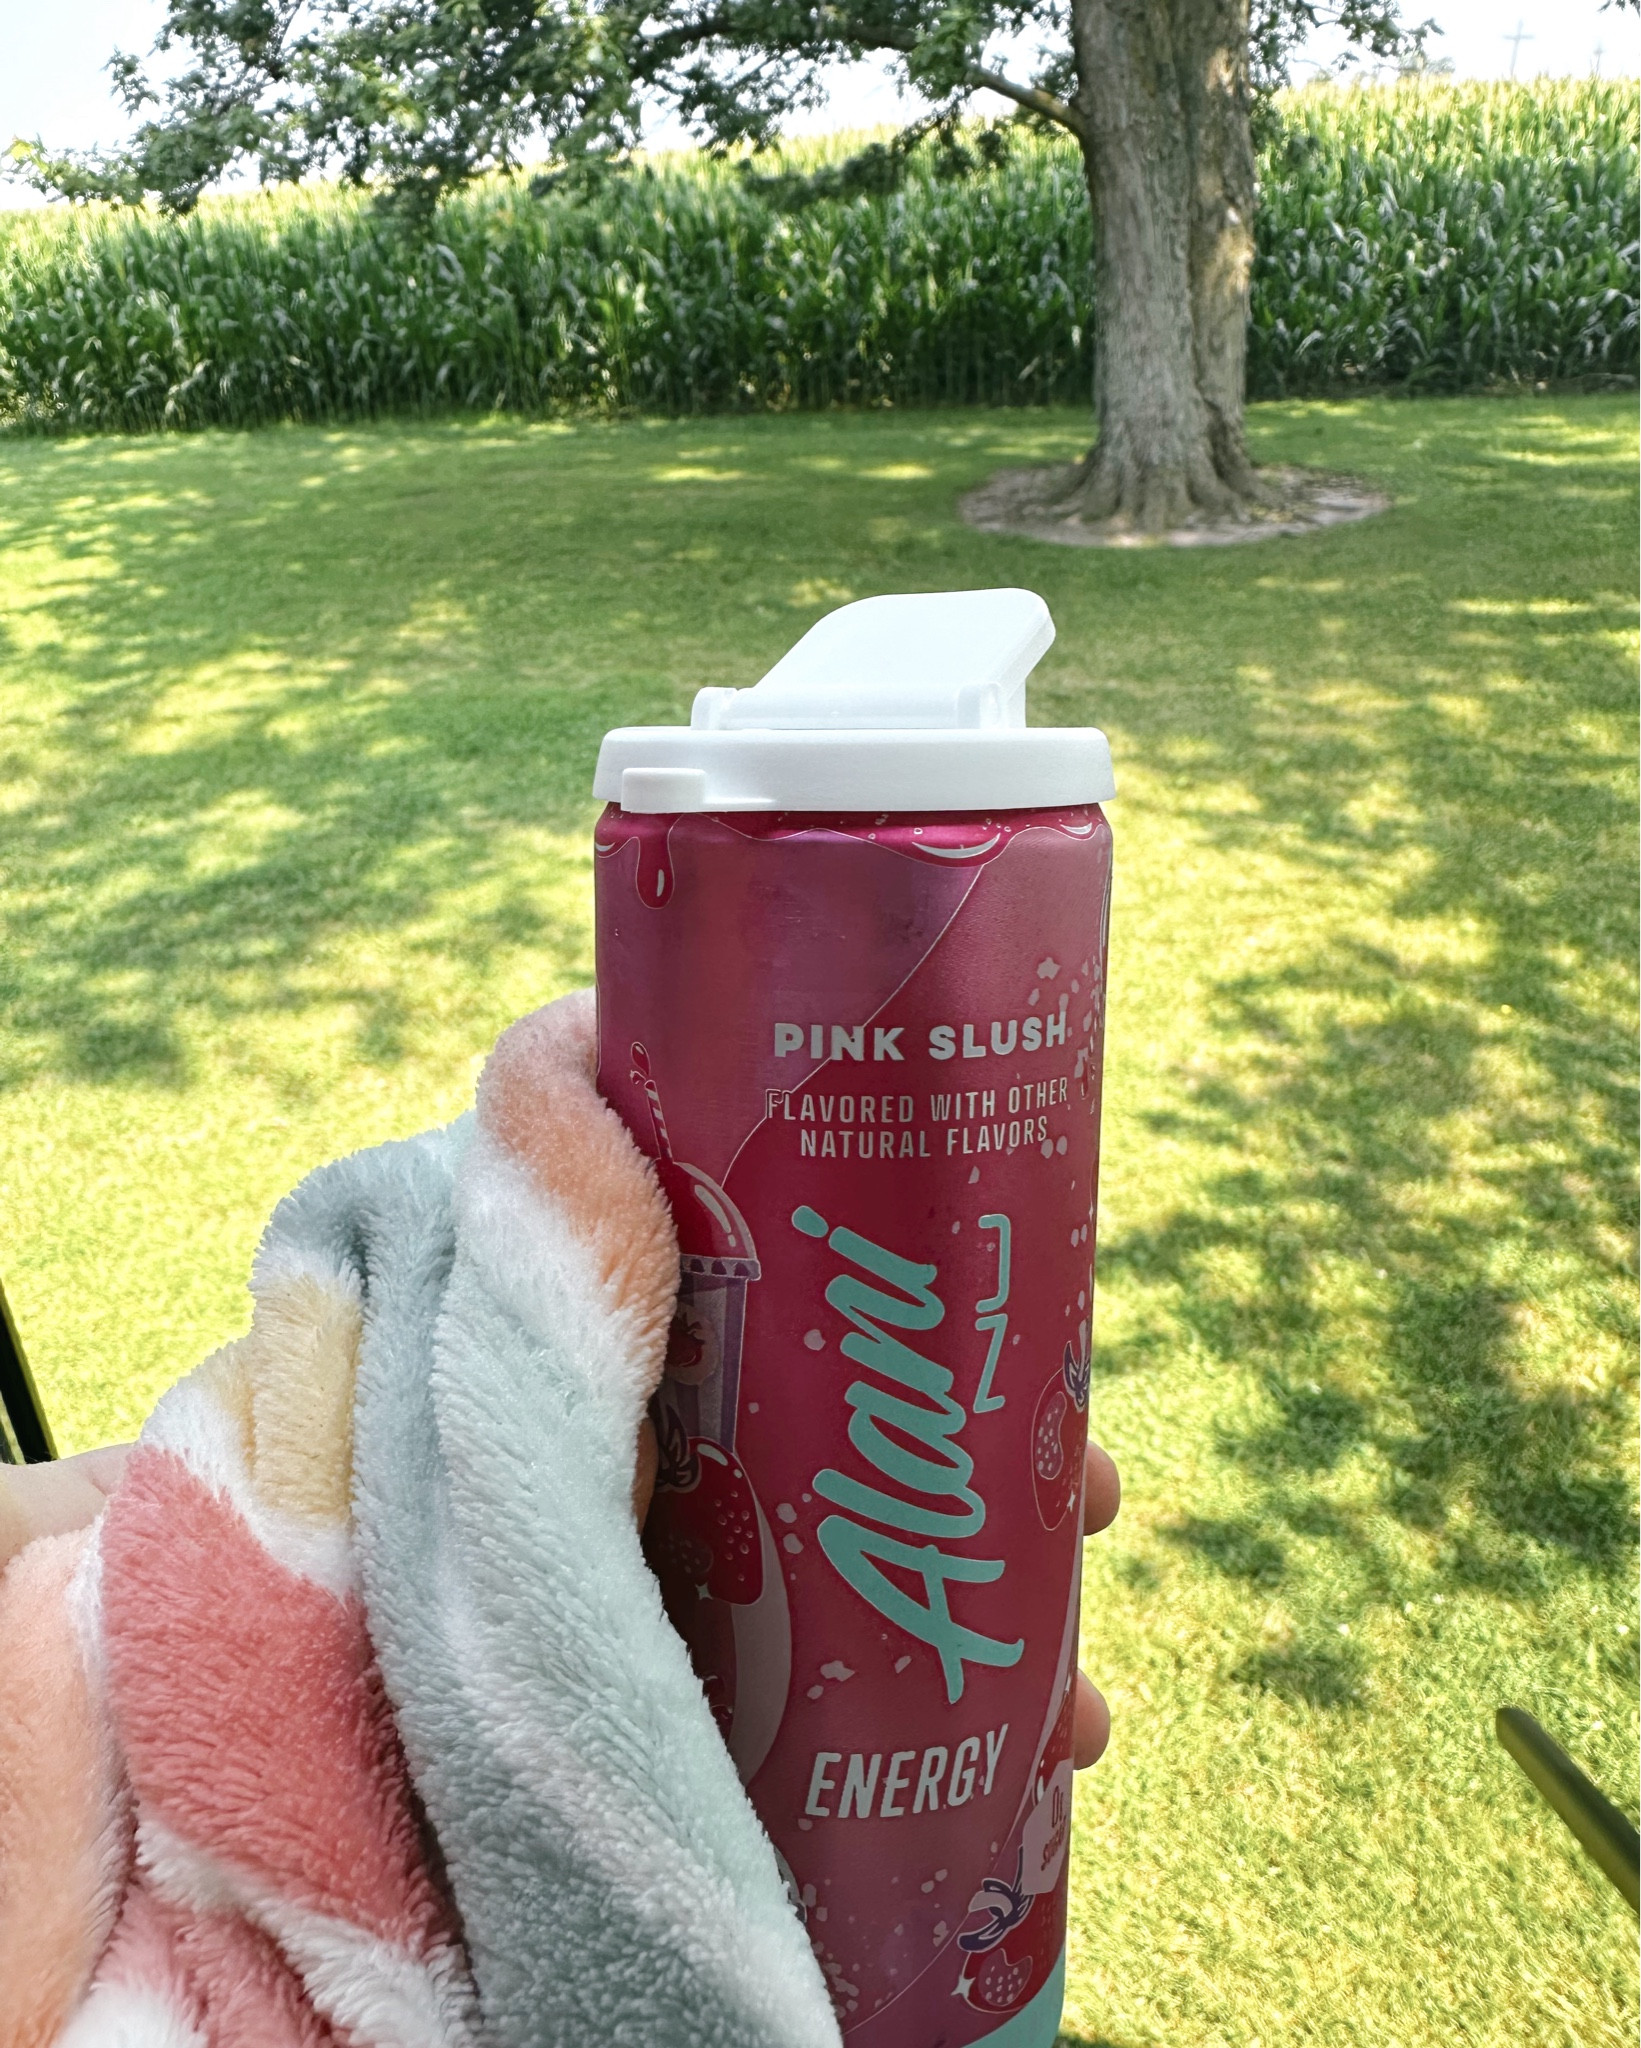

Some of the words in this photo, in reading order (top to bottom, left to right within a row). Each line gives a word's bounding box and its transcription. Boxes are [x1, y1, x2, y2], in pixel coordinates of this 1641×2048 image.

[774, 1022, 904, 1061] PINK
[928, 1010, 1066, 1060] SLUSH
[767, 1092, 914, 1123] FLAVORED
[930, 1090, 995, 1122] WITH
[1008, 1077, 1068, 1115] OTHER
[801, 1129, 931, 1159] NATURAL
[946, 1116, 1048, 1156] FLAVORS
[791, 1205, 1024, 1705] Alani
[804, 1723, 1009, 1819] ENERGY
